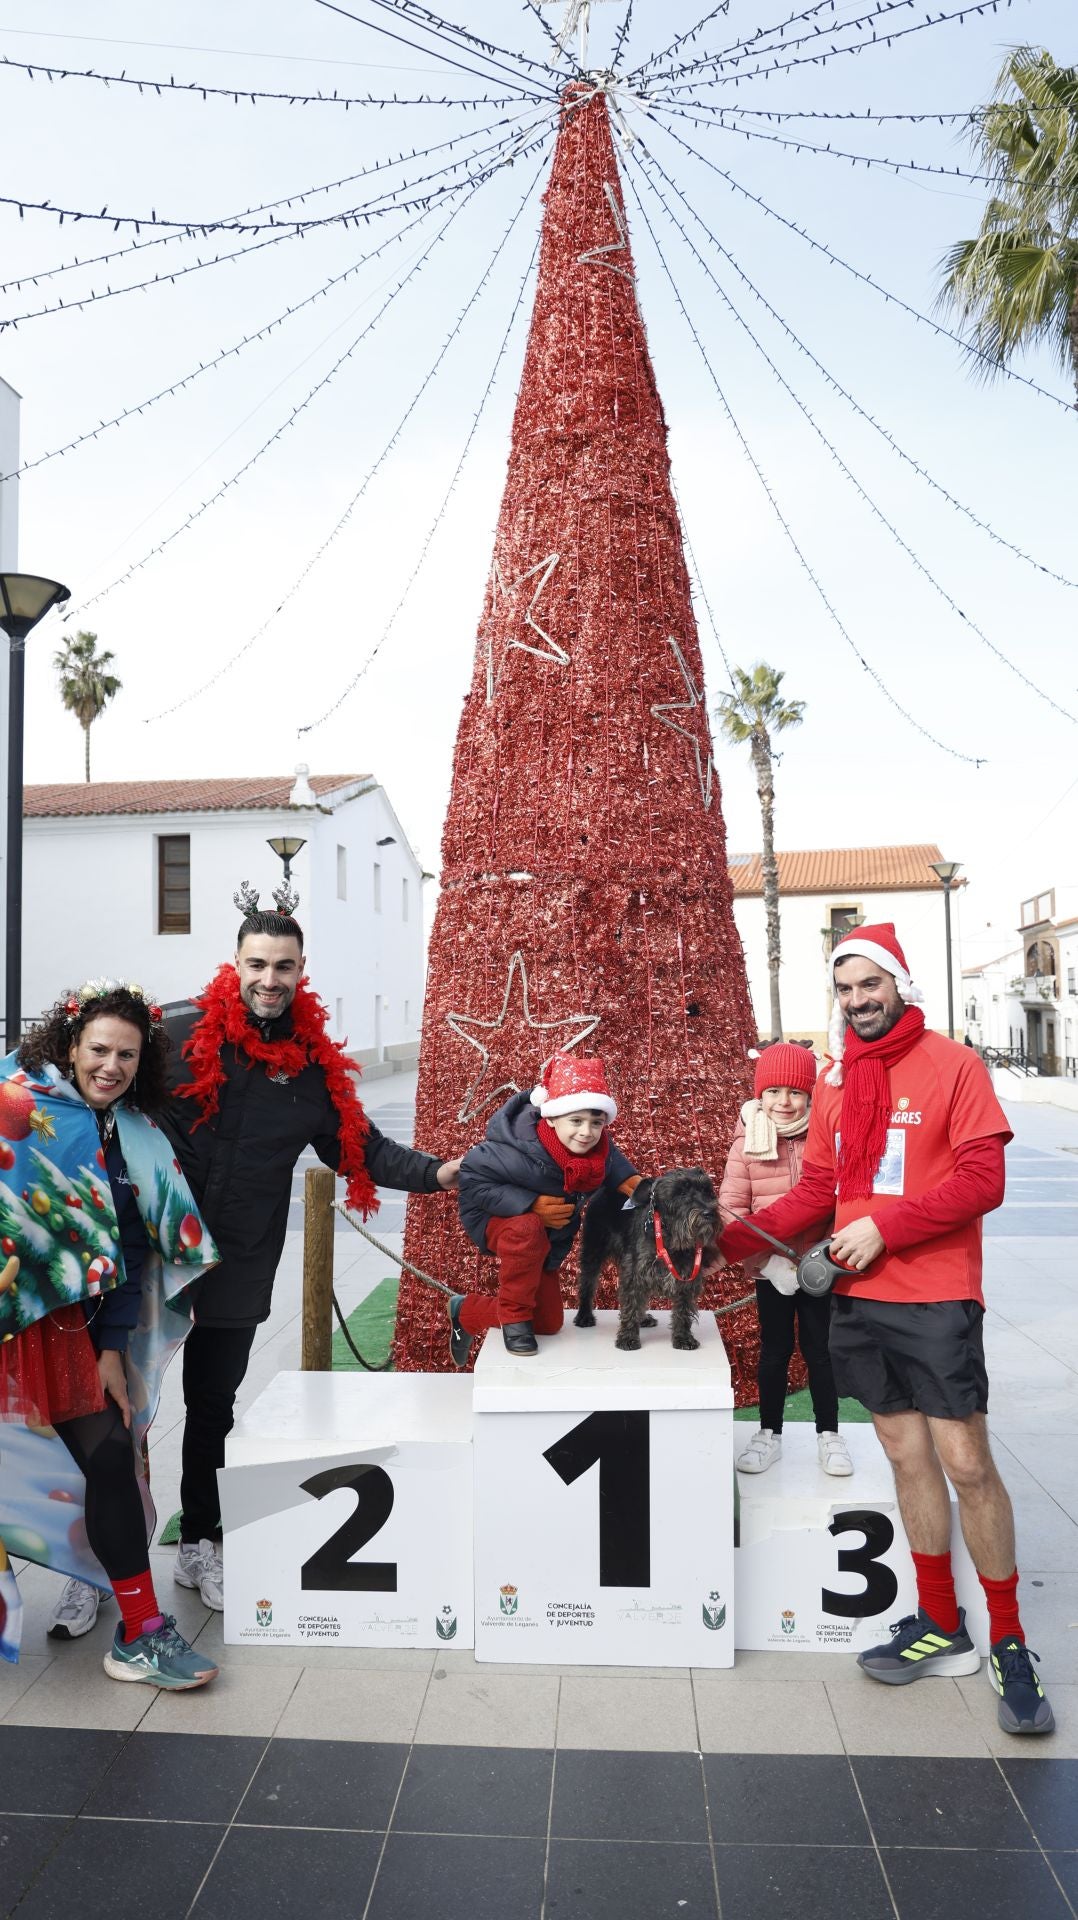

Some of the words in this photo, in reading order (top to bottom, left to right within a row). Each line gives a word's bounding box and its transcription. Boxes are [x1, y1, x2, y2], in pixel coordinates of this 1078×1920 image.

[299, 1464, 397, 1592] 2
[543, 1411, 650, 1587] 1
[547, 1602, 592, 1610] CONCEJALÍA
[821, 1510, 898, 1618] 3
[299, 1615, 338, 1623] CONCEJALÍA
